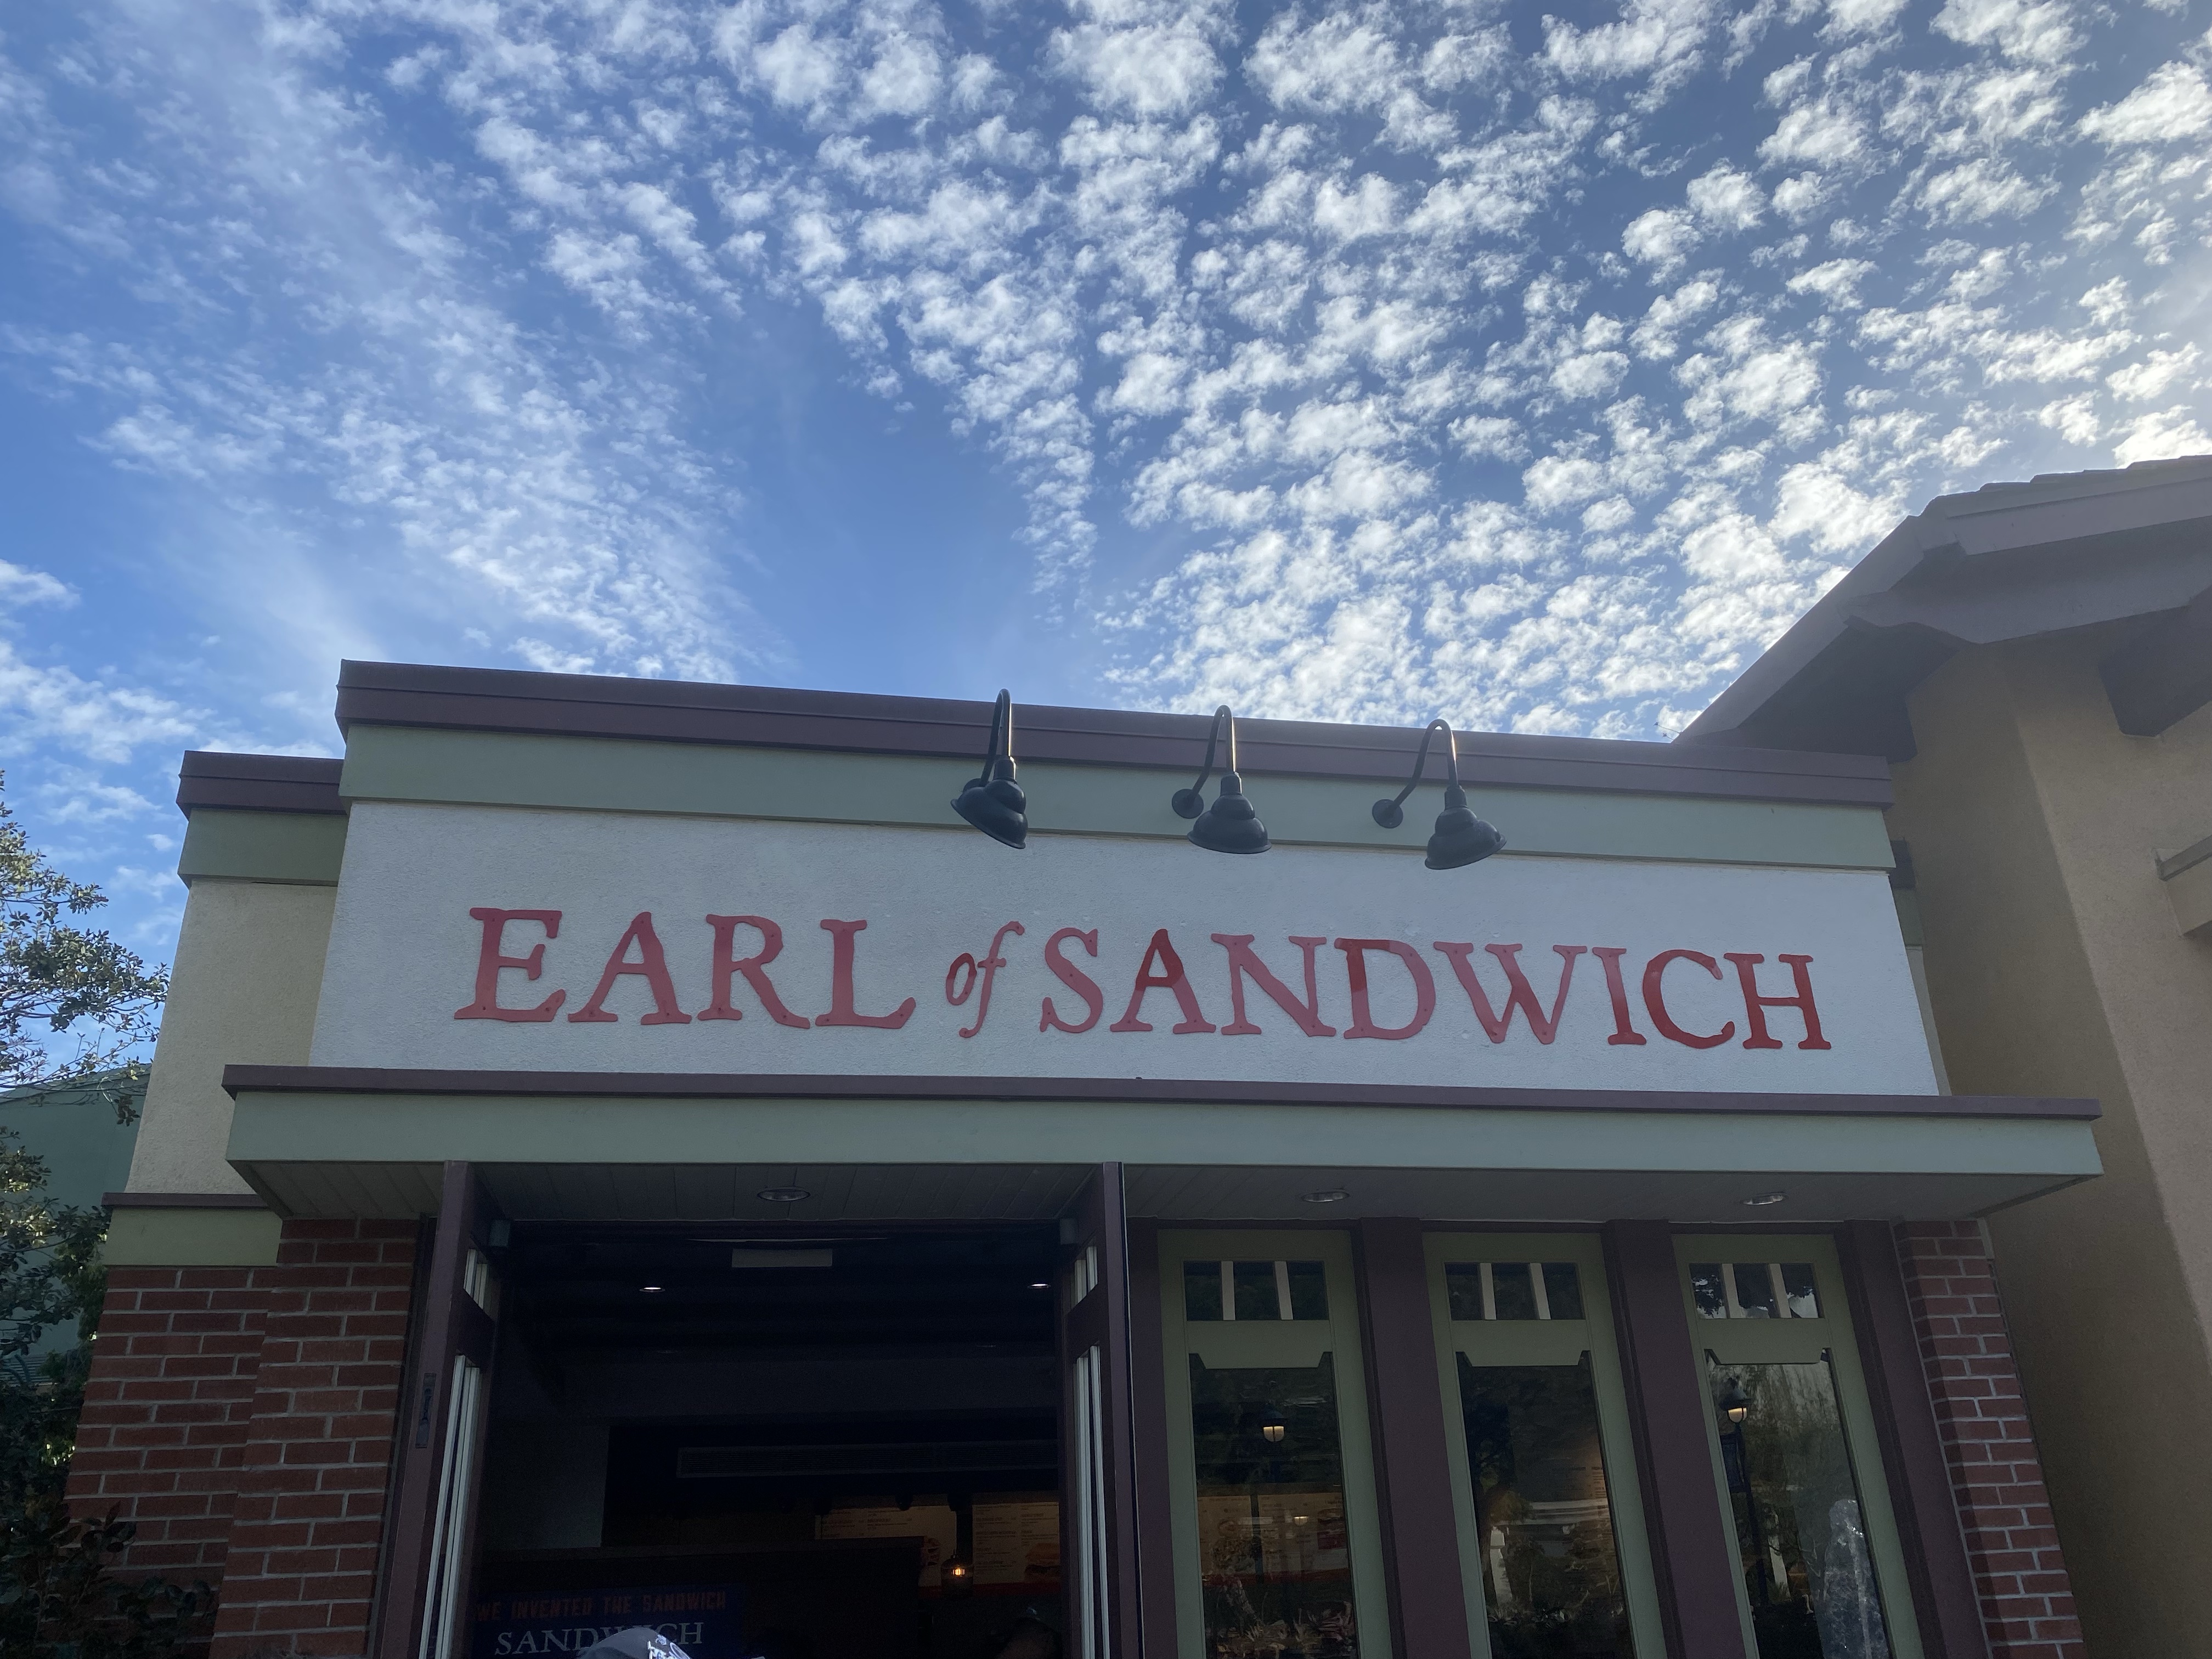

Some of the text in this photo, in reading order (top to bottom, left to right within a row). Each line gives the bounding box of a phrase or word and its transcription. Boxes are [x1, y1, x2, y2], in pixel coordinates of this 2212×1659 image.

[454, 907, 1831, 1049] EARL of SANDWICH
[476, 1592, 725, 1622] WE INVENTED THE SANDWICH
